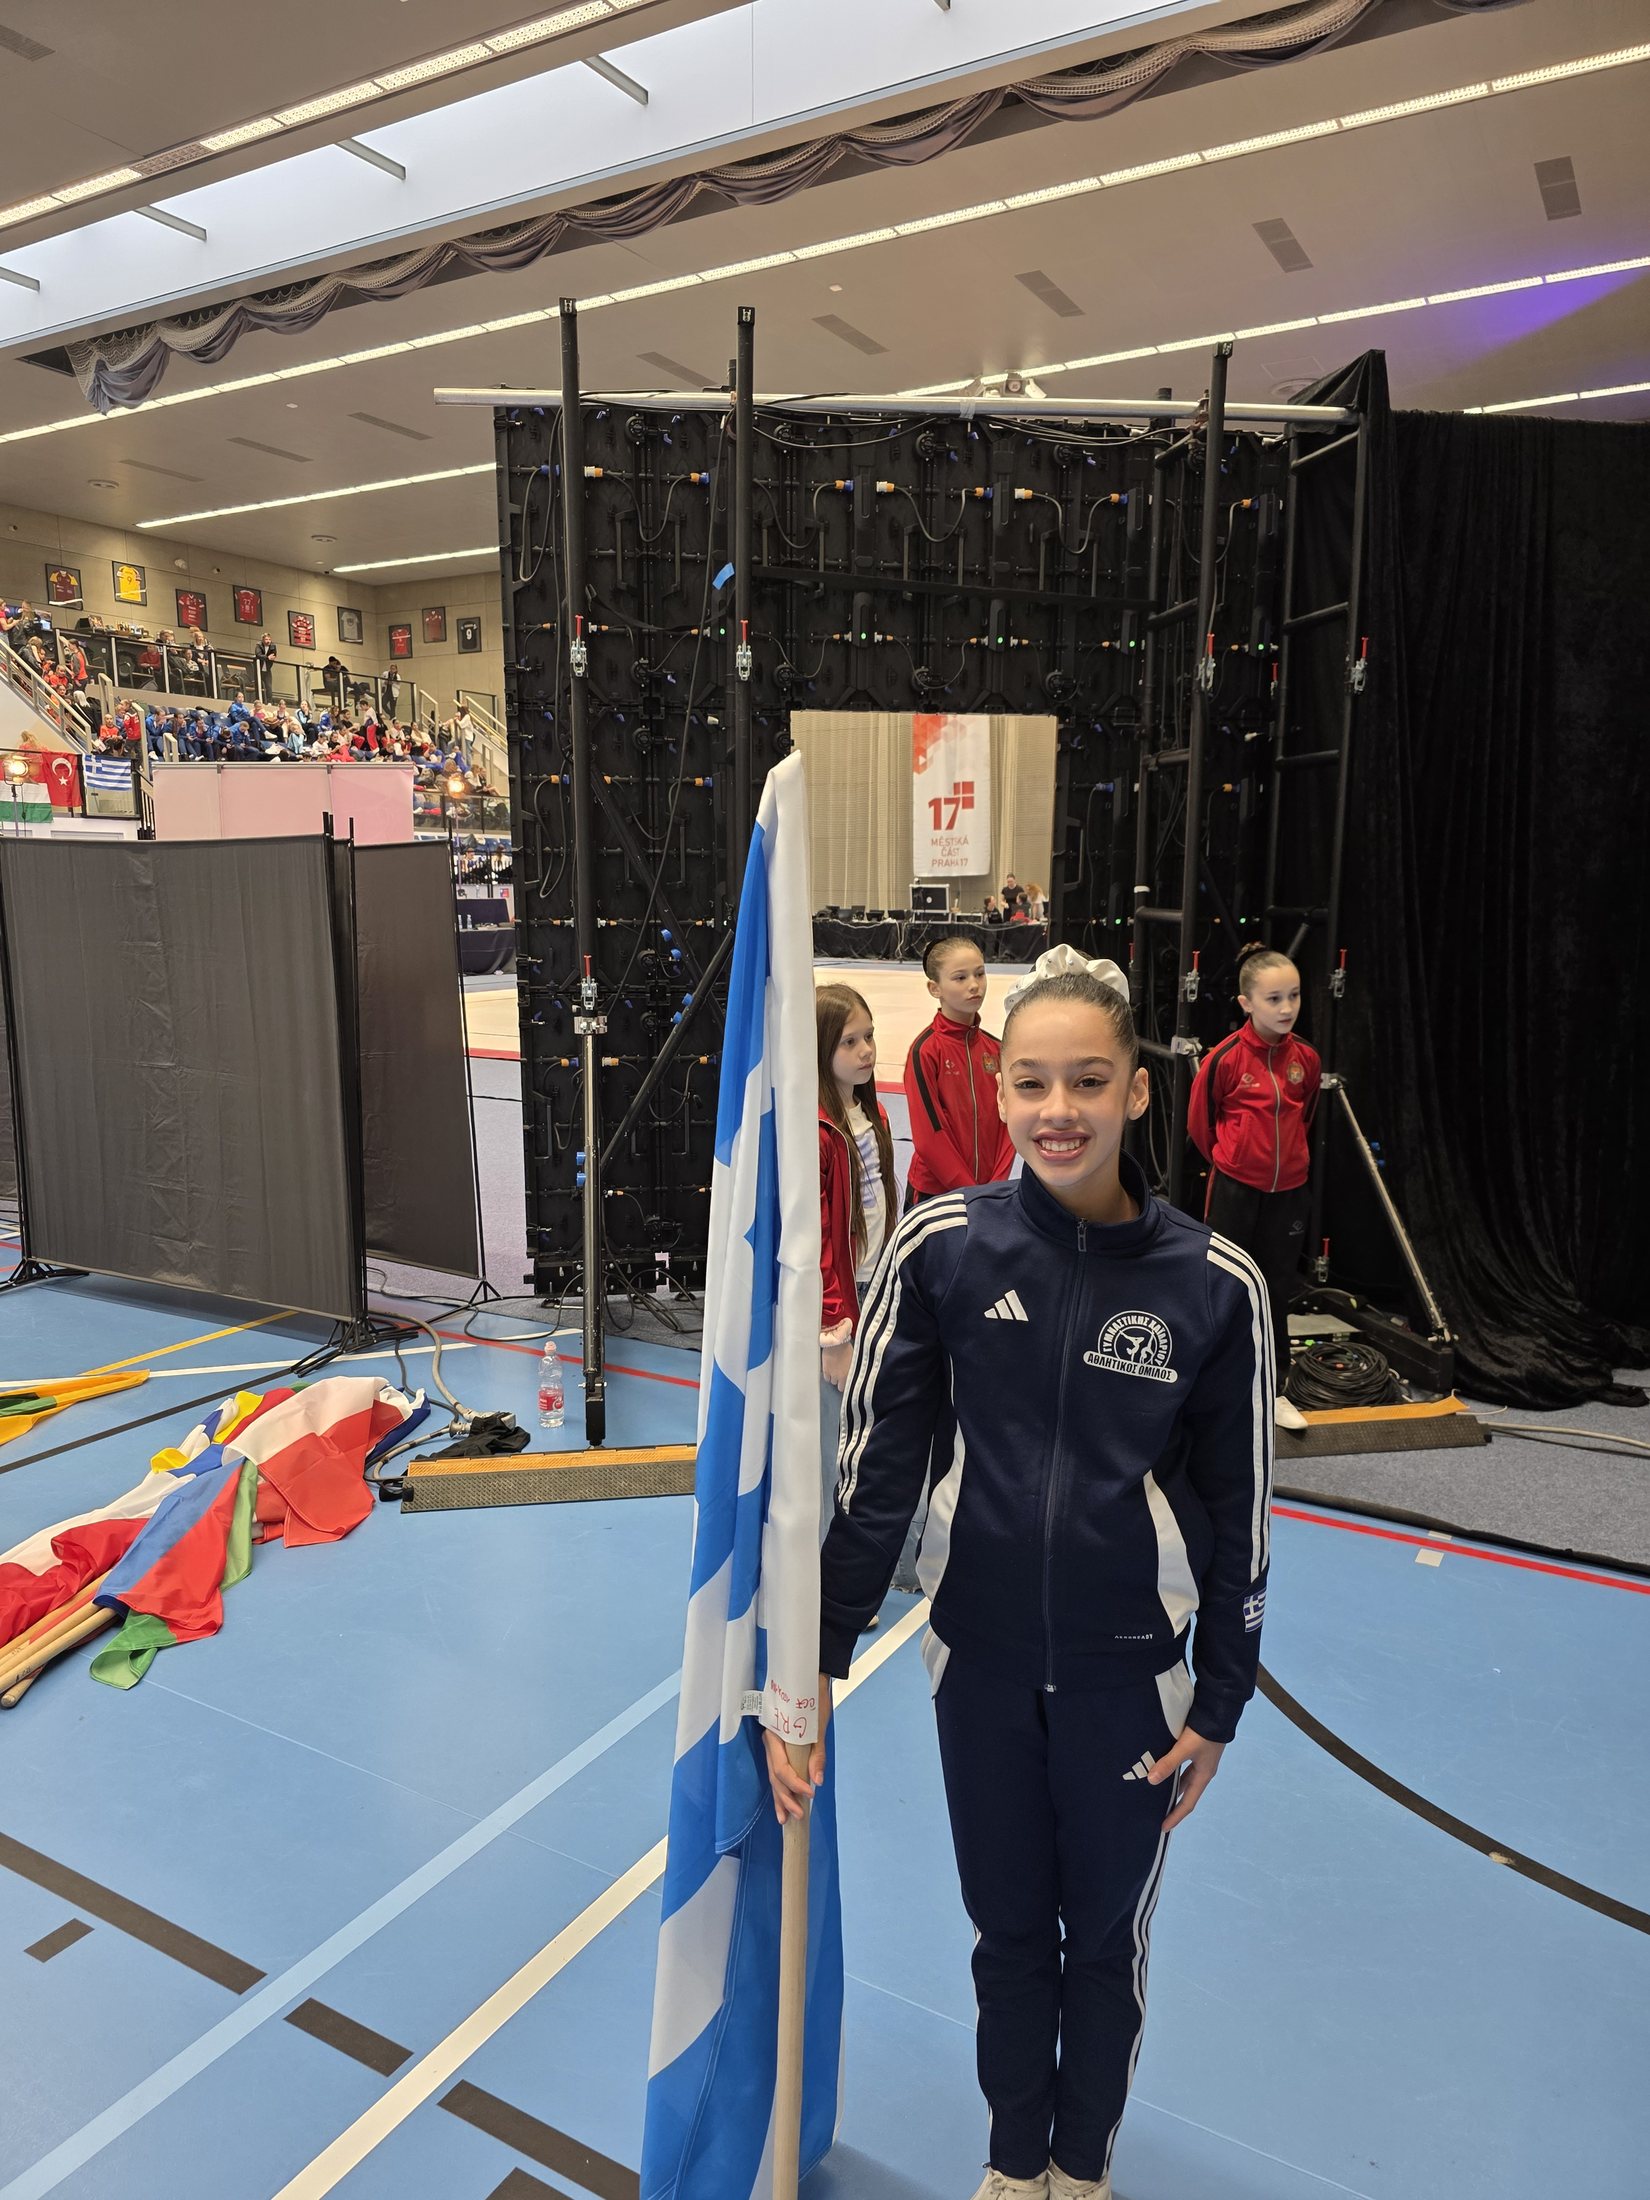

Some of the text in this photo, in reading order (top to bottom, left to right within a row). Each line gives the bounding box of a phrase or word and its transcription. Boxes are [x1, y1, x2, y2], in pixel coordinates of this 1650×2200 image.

[466, 628, 472, 640] 9
[928, 797, 962, 831] 17
[960, 857, 969, 867] 17
[1103, 1315, 1149, 1352] ΓΥΜΝΑΣΤΙΚΗΣ
[1087, 1352, 1172, 1381] ΑΘΛΗΤΙΚΟΣ ΟΜΙΛΟΣ
